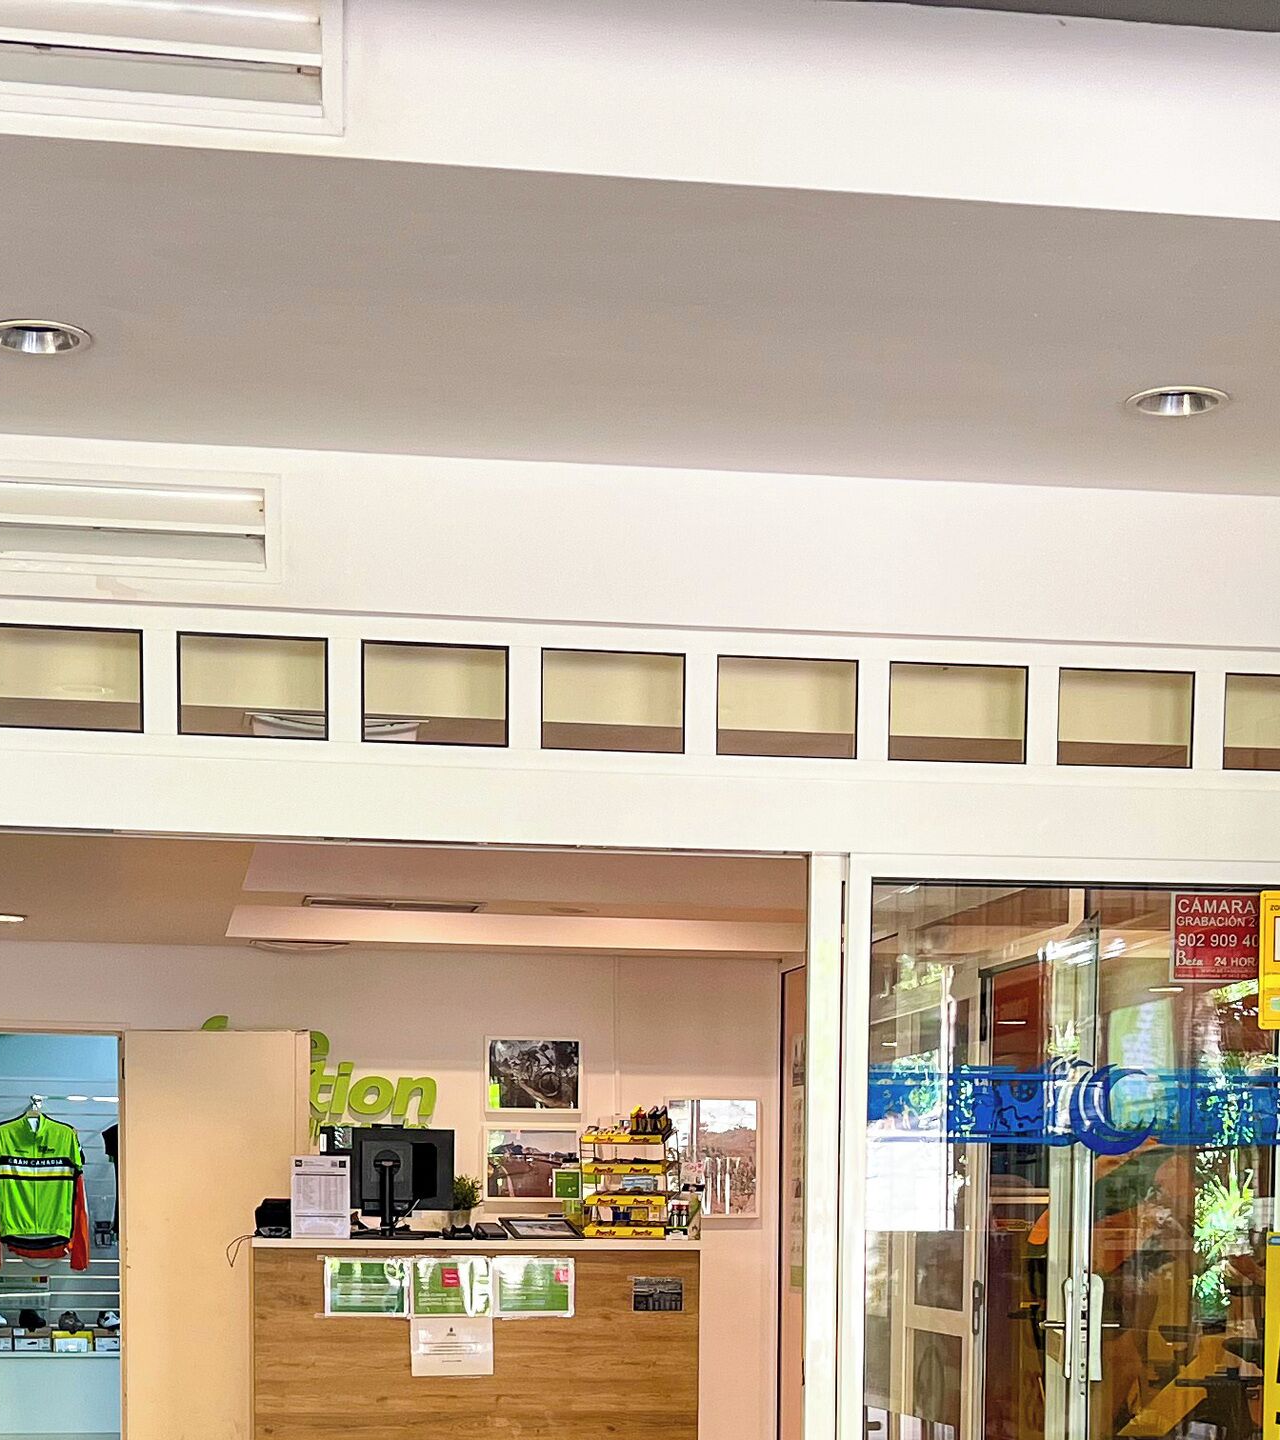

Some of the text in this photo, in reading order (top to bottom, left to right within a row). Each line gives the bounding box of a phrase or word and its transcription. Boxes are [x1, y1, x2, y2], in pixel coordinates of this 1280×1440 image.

[1176, 915, 1246, 927] GRABACIÓN
[1178, 933, 1205, 947] 902
[1210, 934, 1238, 947] 909
[1214, 956, 1227, 966] 24
[310, 1062, 437, 1116] tion
